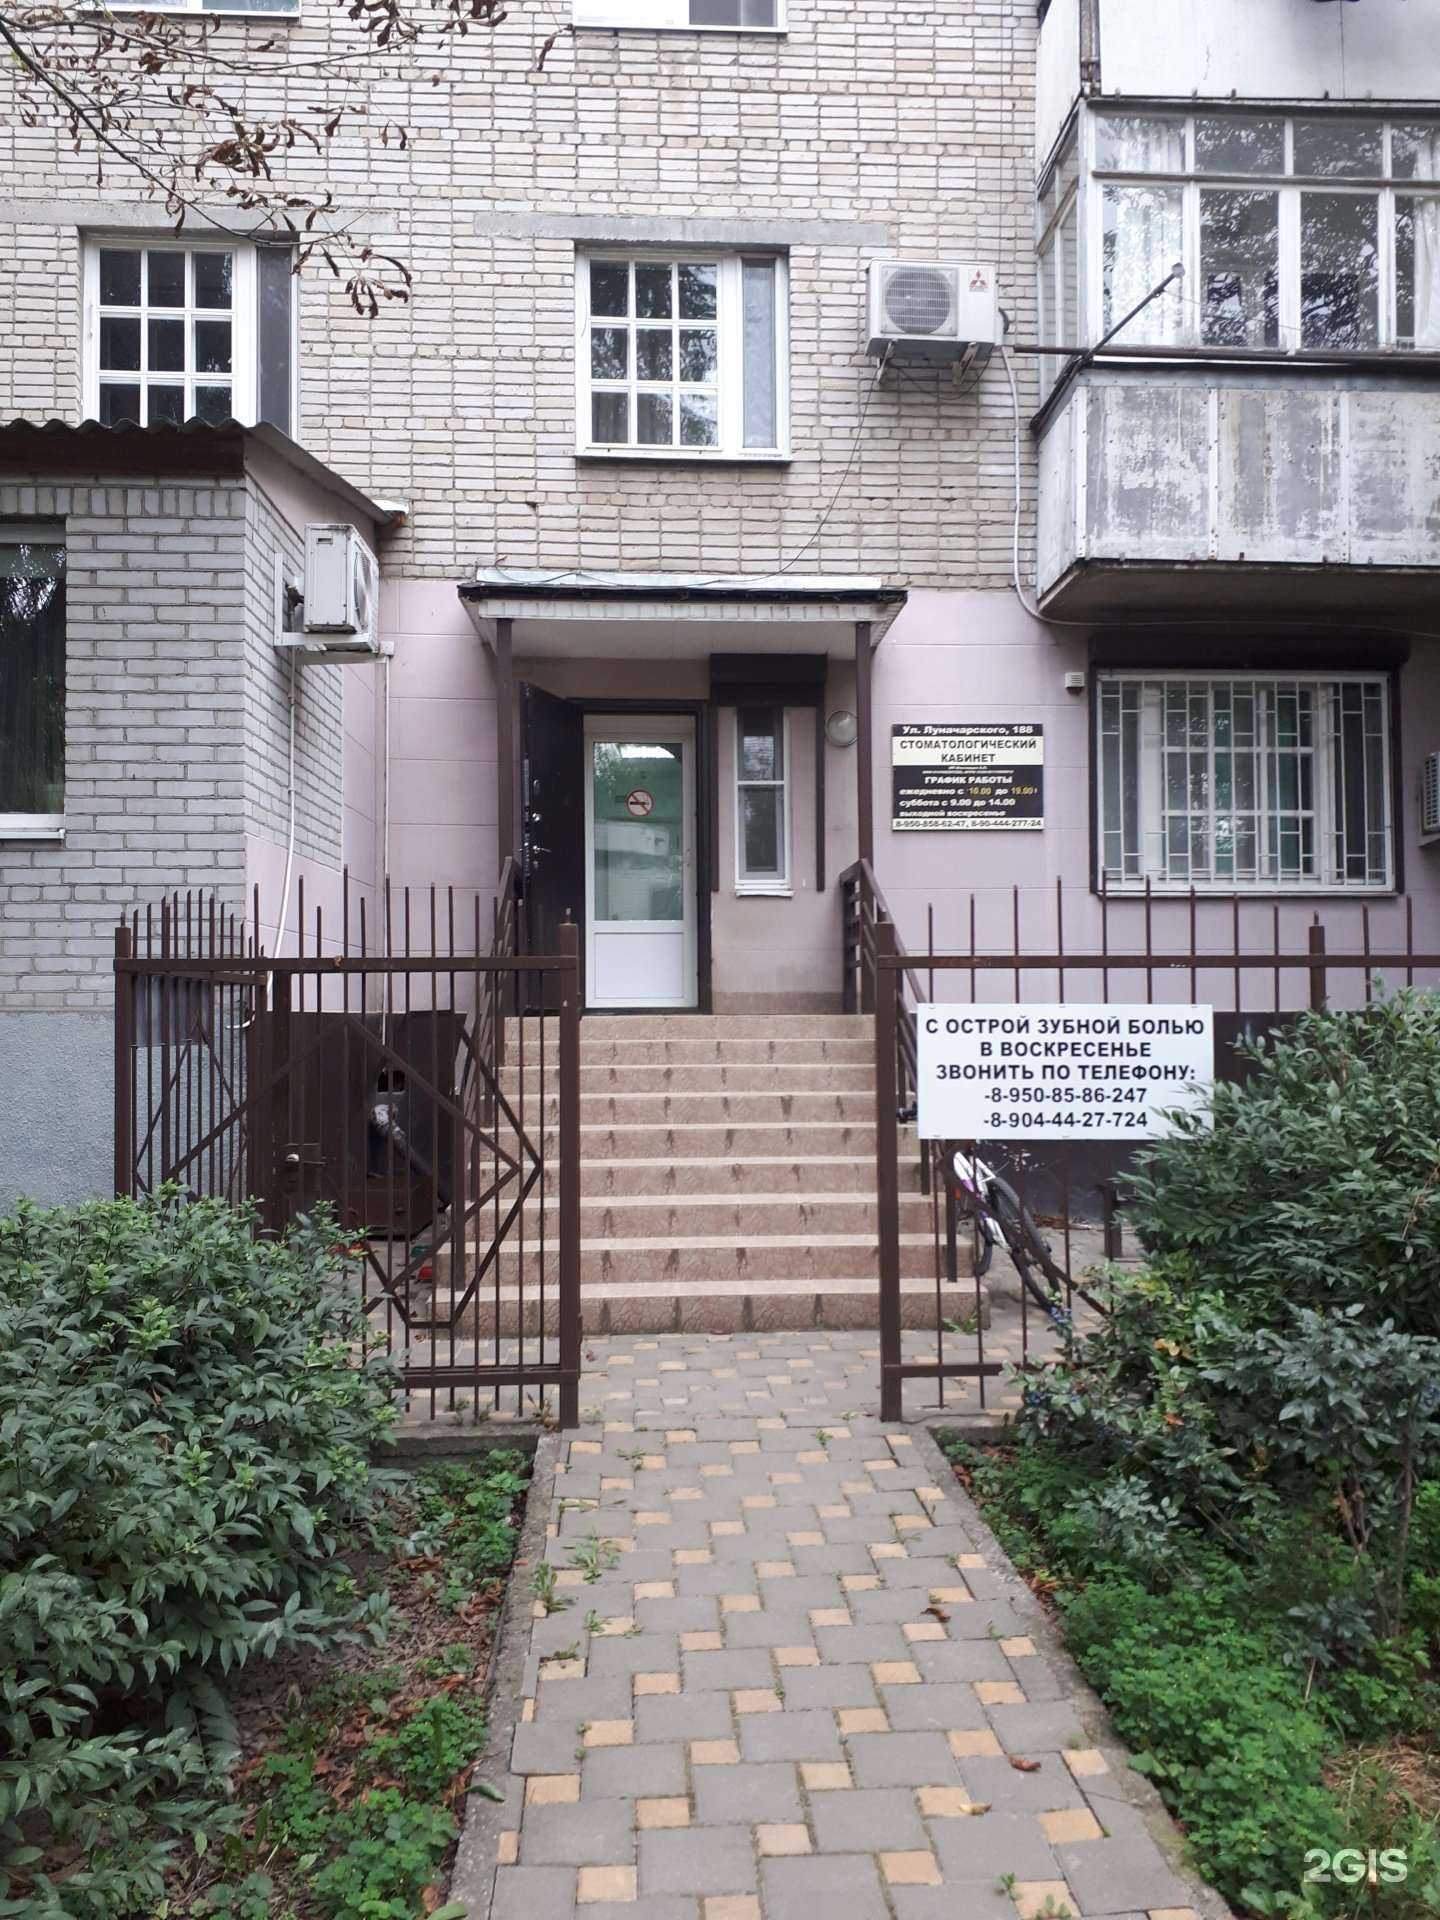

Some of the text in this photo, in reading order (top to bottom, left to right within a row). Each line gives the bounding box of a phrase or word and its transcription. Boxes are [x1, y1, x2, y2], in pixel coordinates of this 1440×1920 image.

[902, 726, 1033, 736] Ул. Луначарского, 188
[900, 738, 1037, 749] СТОМАТОЛОГИЧЕСКИЙ
[941, 753, 996, 763] КАБИНЕТ
[924, 776, 1013, 784] ГРАФИК РАБОТЫ
[899, 788, 956, 796] ежедневно
[995, 788, 1008, 796] до
[899, 799, 940, 808] суббота
[950, 799, 972, 807] 9.00
[989, 799, 1016, 807] 14.00
[926, 1016, 1205, 1035] С ОСТРОЙ ЗУБНОЙ БОЛЬЮ
[980, 1042, 1151, 1057] В ВОСКРЕСЕНЬЕ
[936, 1064, 1196, 1081] ЗВОНИТЬ ПО ТЕЛЕФОНУ:
[984, 1088, 1147, 1103] -8-950-85-86-247
[984, 1112, 1148, 1128] -8-904-44-27-724
